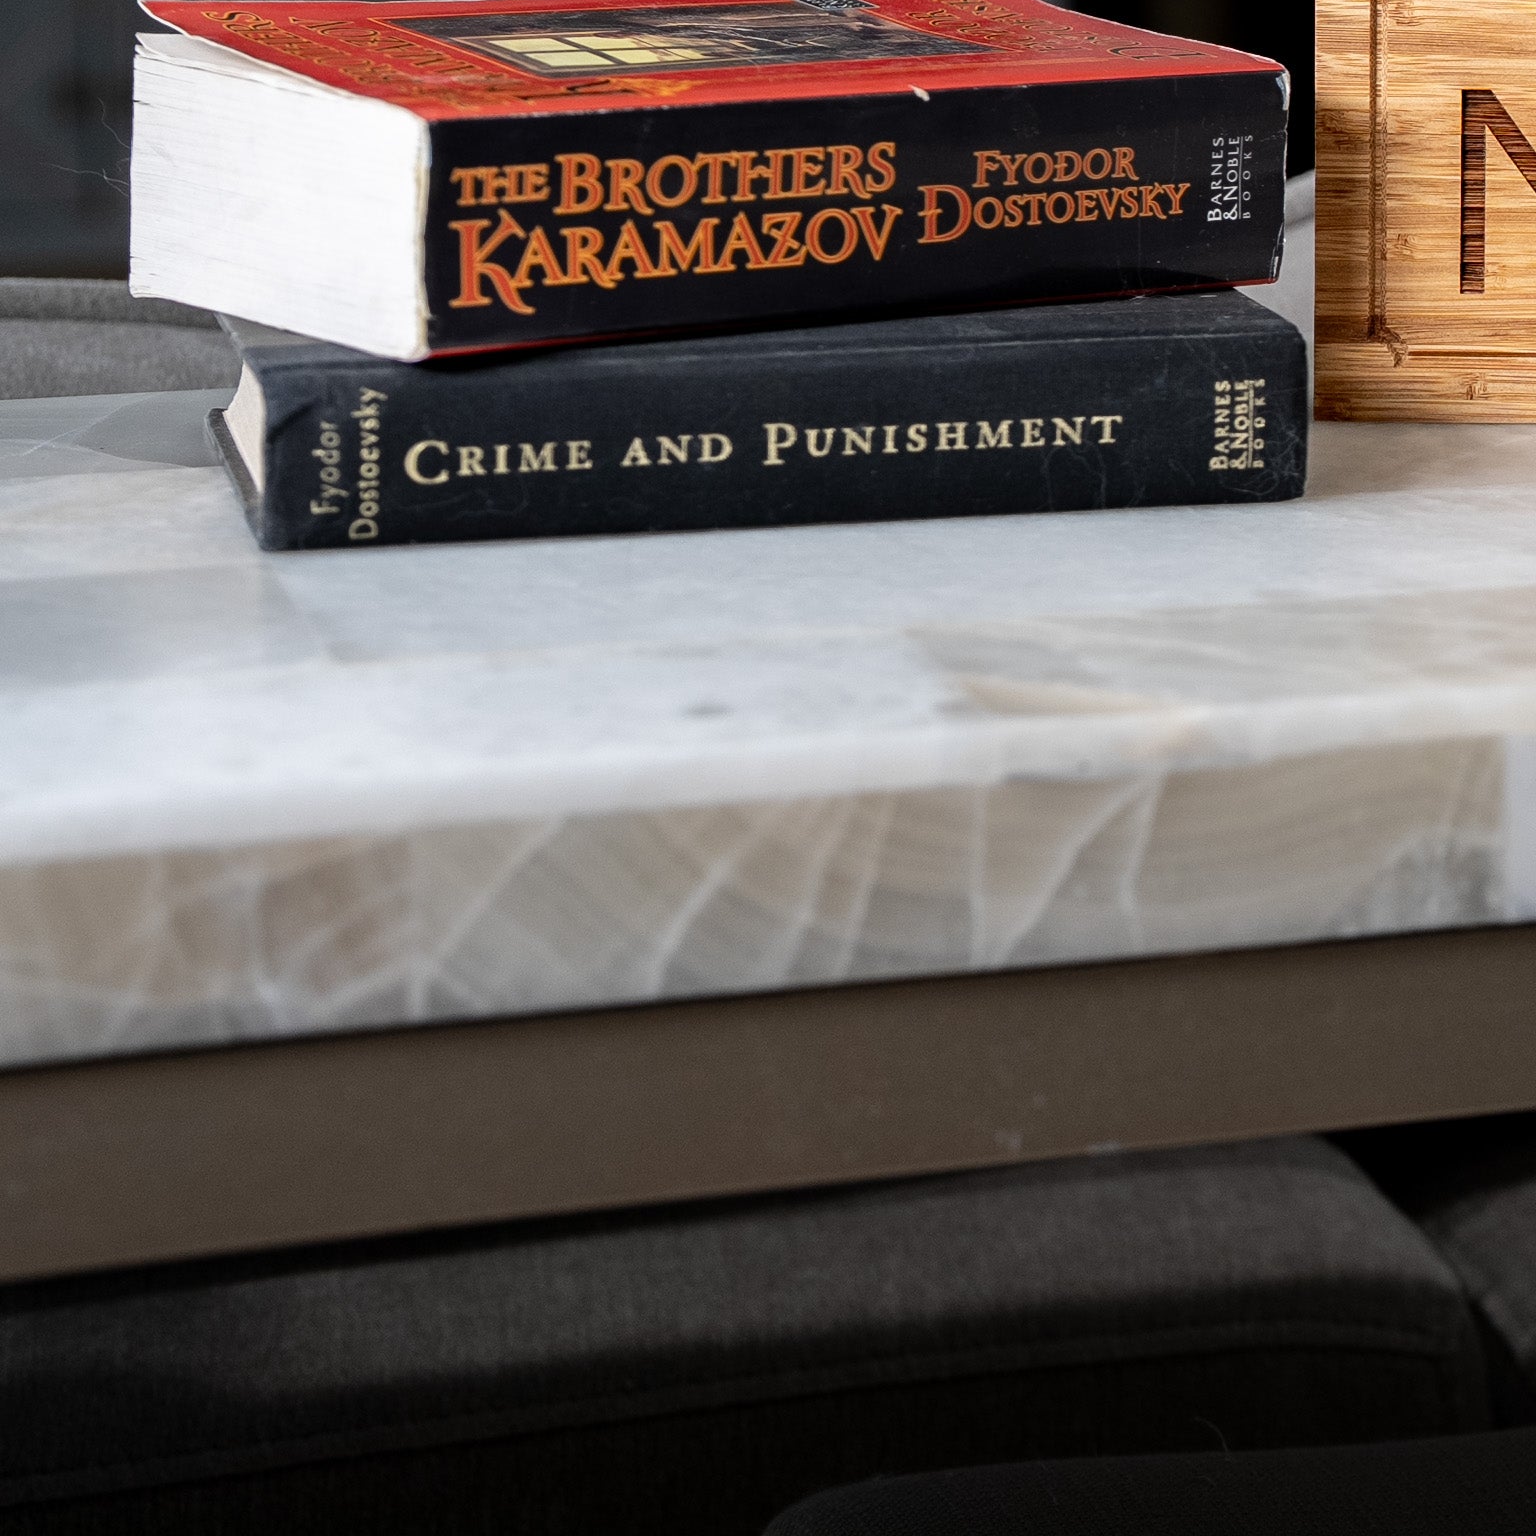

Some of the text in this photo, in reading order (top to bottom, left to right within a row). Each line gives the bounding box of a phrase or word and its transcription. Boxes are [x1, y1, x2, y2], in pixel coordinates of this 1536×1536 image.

[449, 141, 897, 216] THE BROTHERS
[972, 147, 1139, 187] FYODOR
[1207, 137, 1225, 222] BARNES
[1242, 135, 1254, 219] BOOKS
[917, 182, 1191, 244] DOSTOEVSKY
[448, 204, 903, 315] KARAMAZOV
[310, 420, 349, 515] Fyodor
[348, 386, 389, 540] Dostoevsky
[404, 415, 1124, 485] CRIME AND PUNISHMENT
[1208, 380, 1231, 471] BARNES
